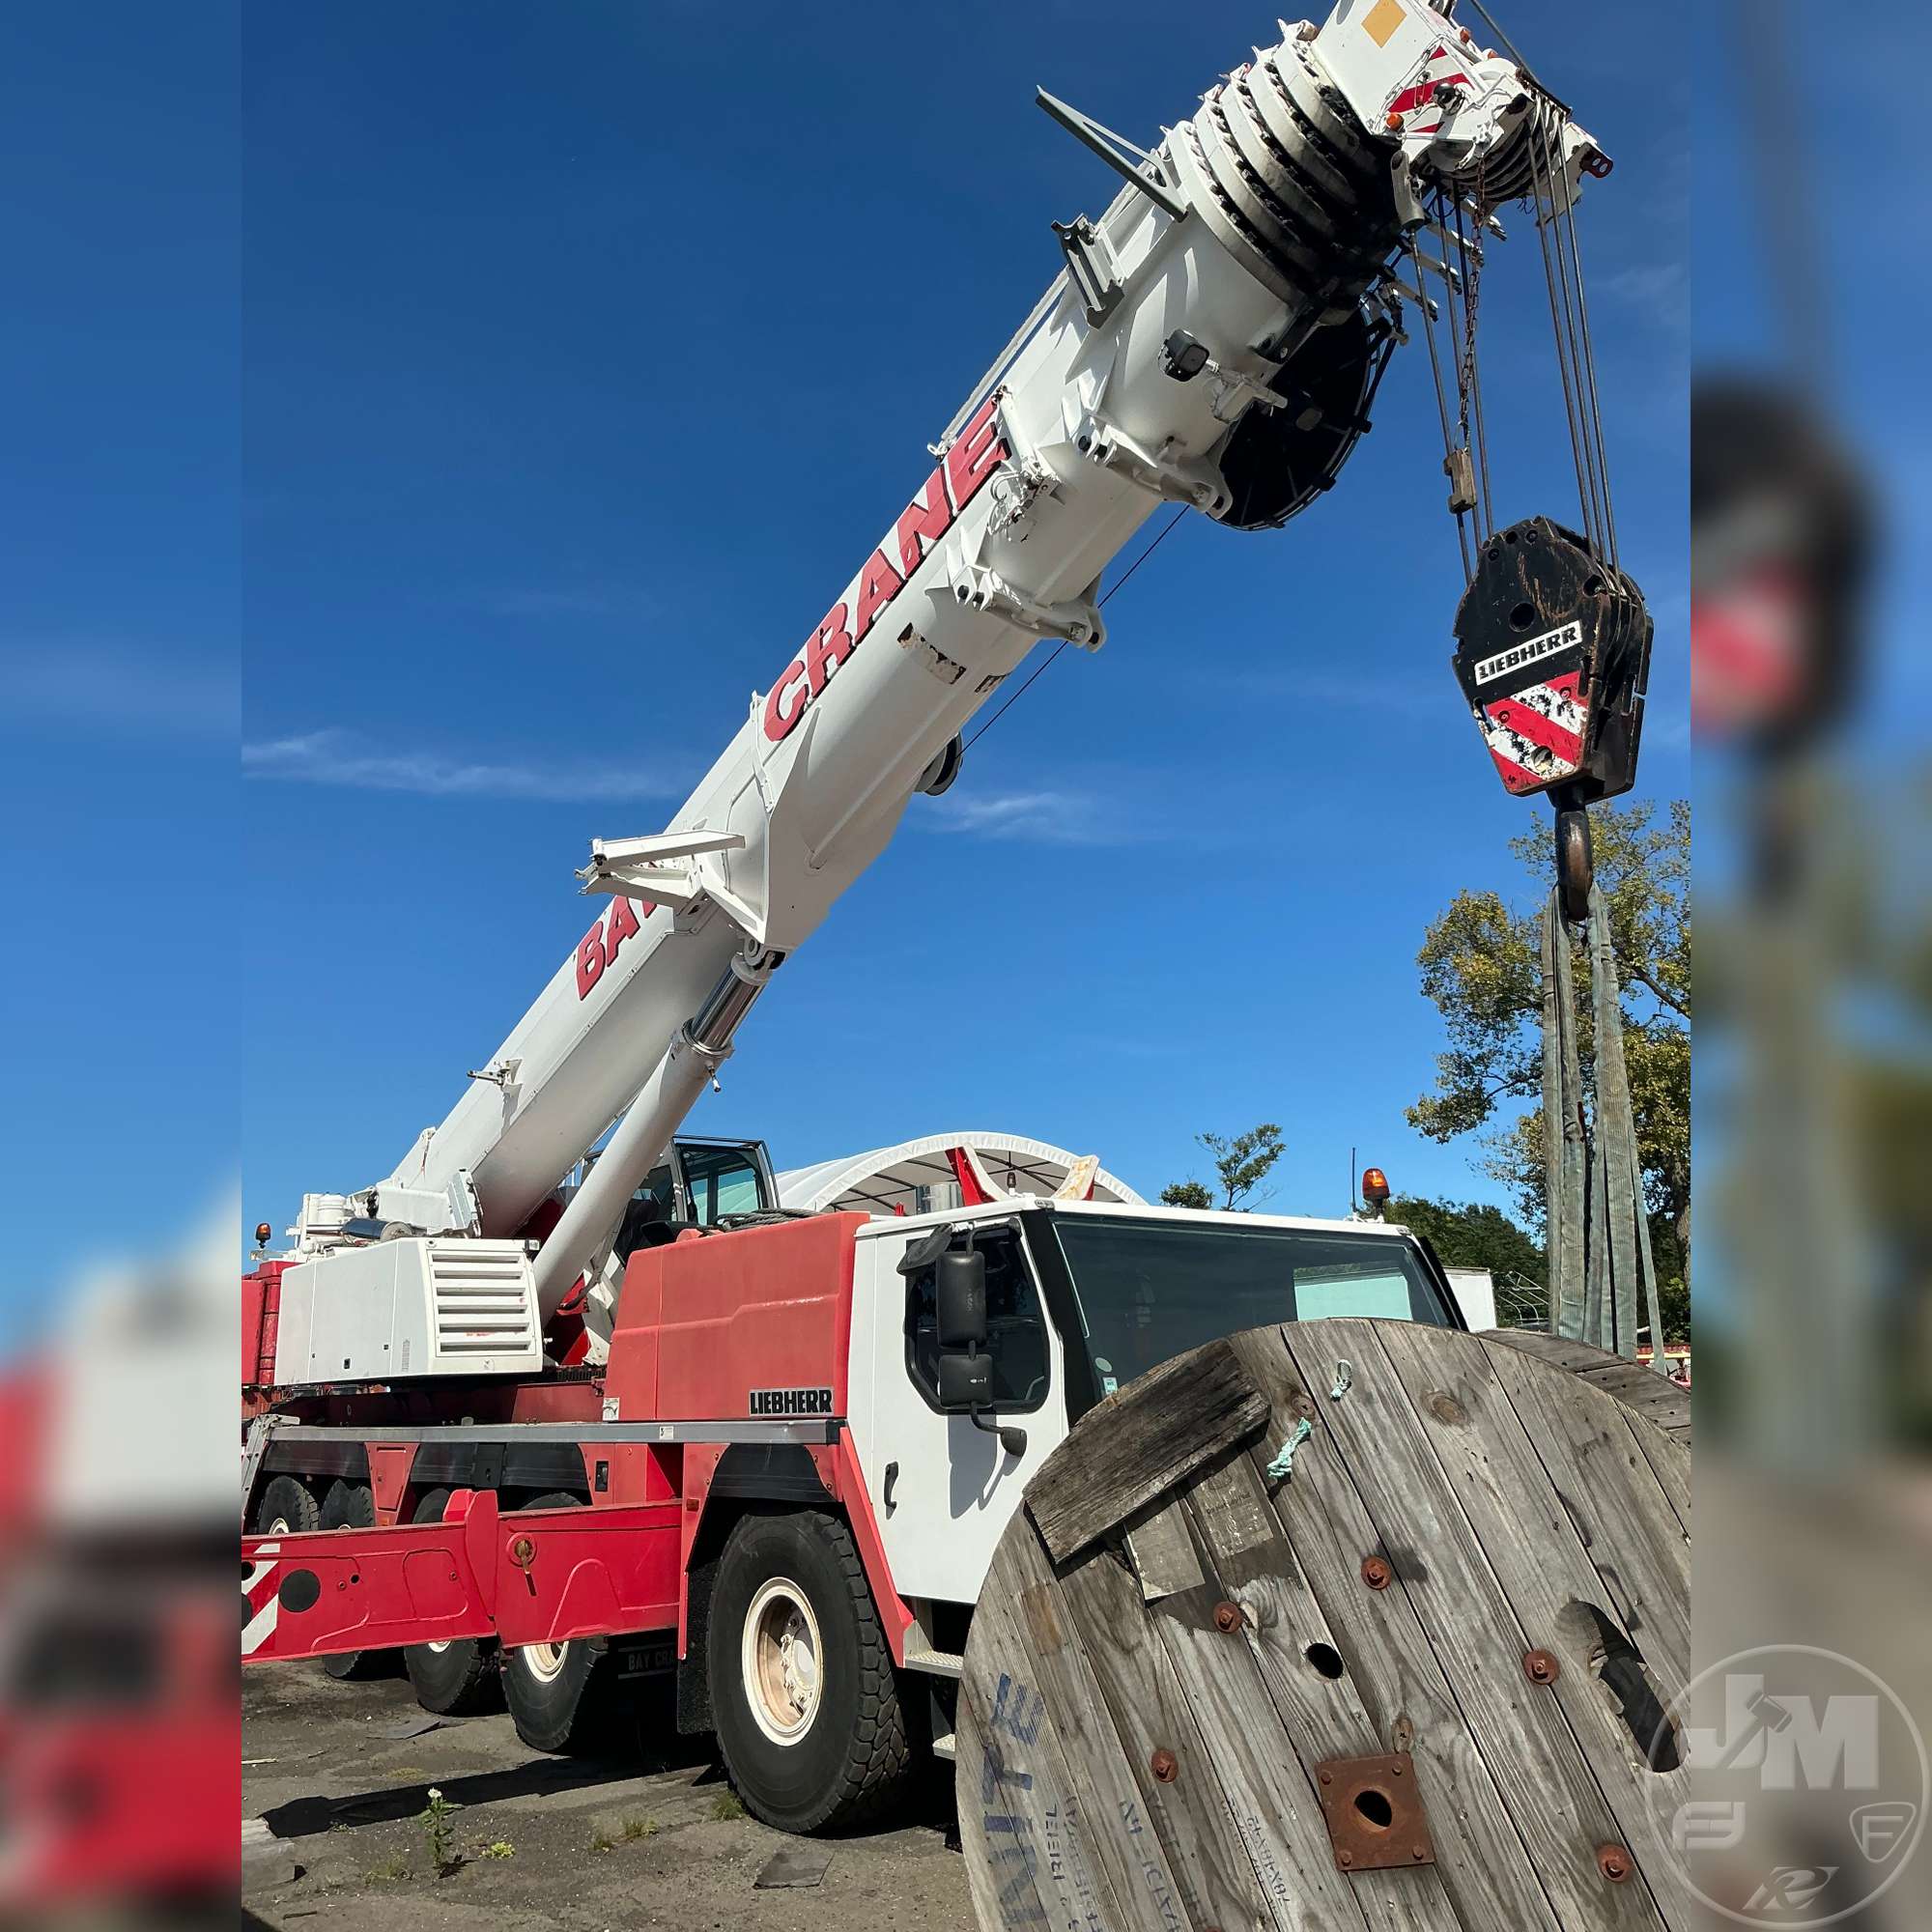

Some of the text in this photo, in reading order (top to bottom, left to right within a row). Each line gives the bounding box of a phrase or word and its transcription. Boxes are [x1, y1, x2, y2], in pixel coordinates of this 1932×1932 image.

[1479, 626, 1577, 679] LIEBHERR
[577, 395, 1011, 1001] BA CRANE
[750, 1390, 832, 1414] LIEBHERR
